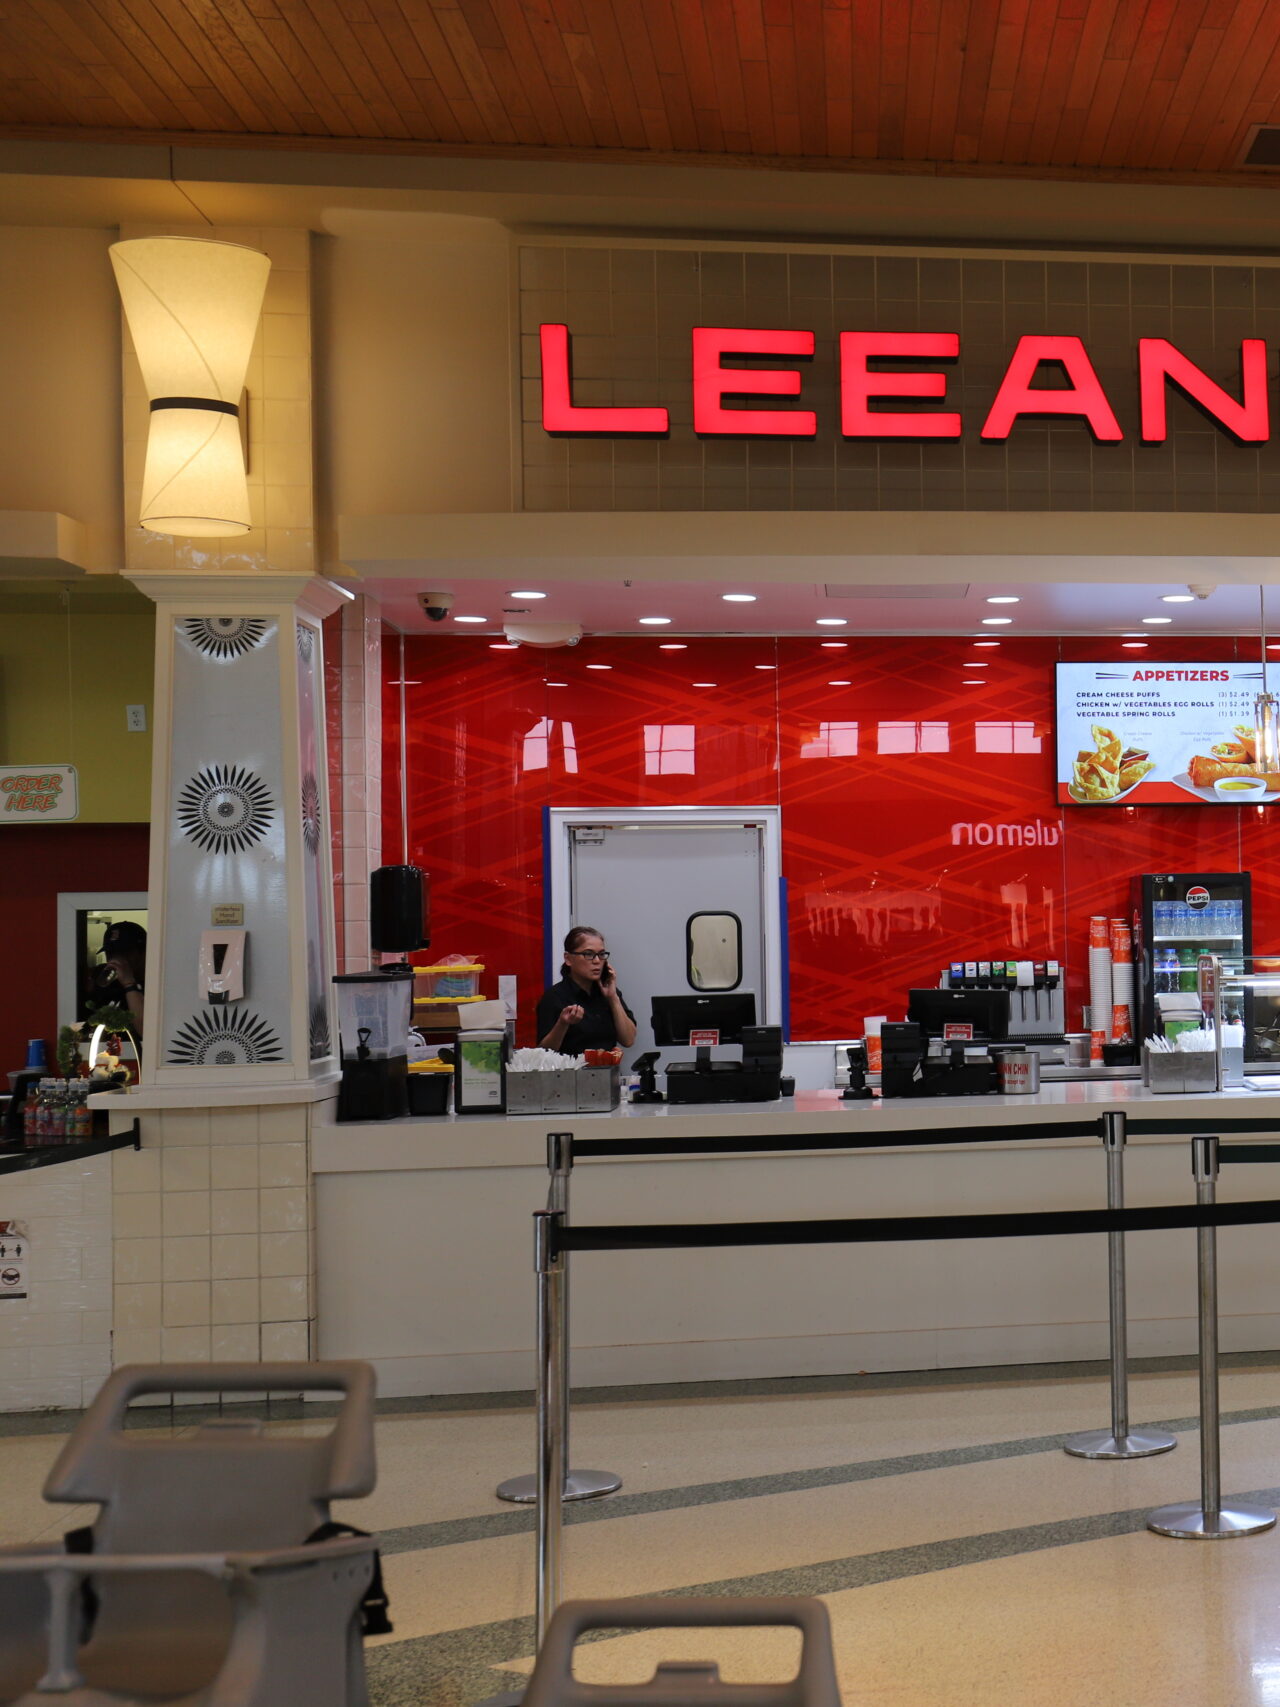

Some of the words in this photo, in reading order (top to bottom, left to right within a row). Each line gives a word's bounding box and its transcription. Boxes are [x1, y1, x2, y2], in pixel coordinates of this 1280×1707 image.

[1132, 670, 1230, 681] APPETIZERS
[0, 774, 63, 793] ORDER
[4, 793, 58, 812] HERE
[1013, 1063, 1028, 1075] CHIN
